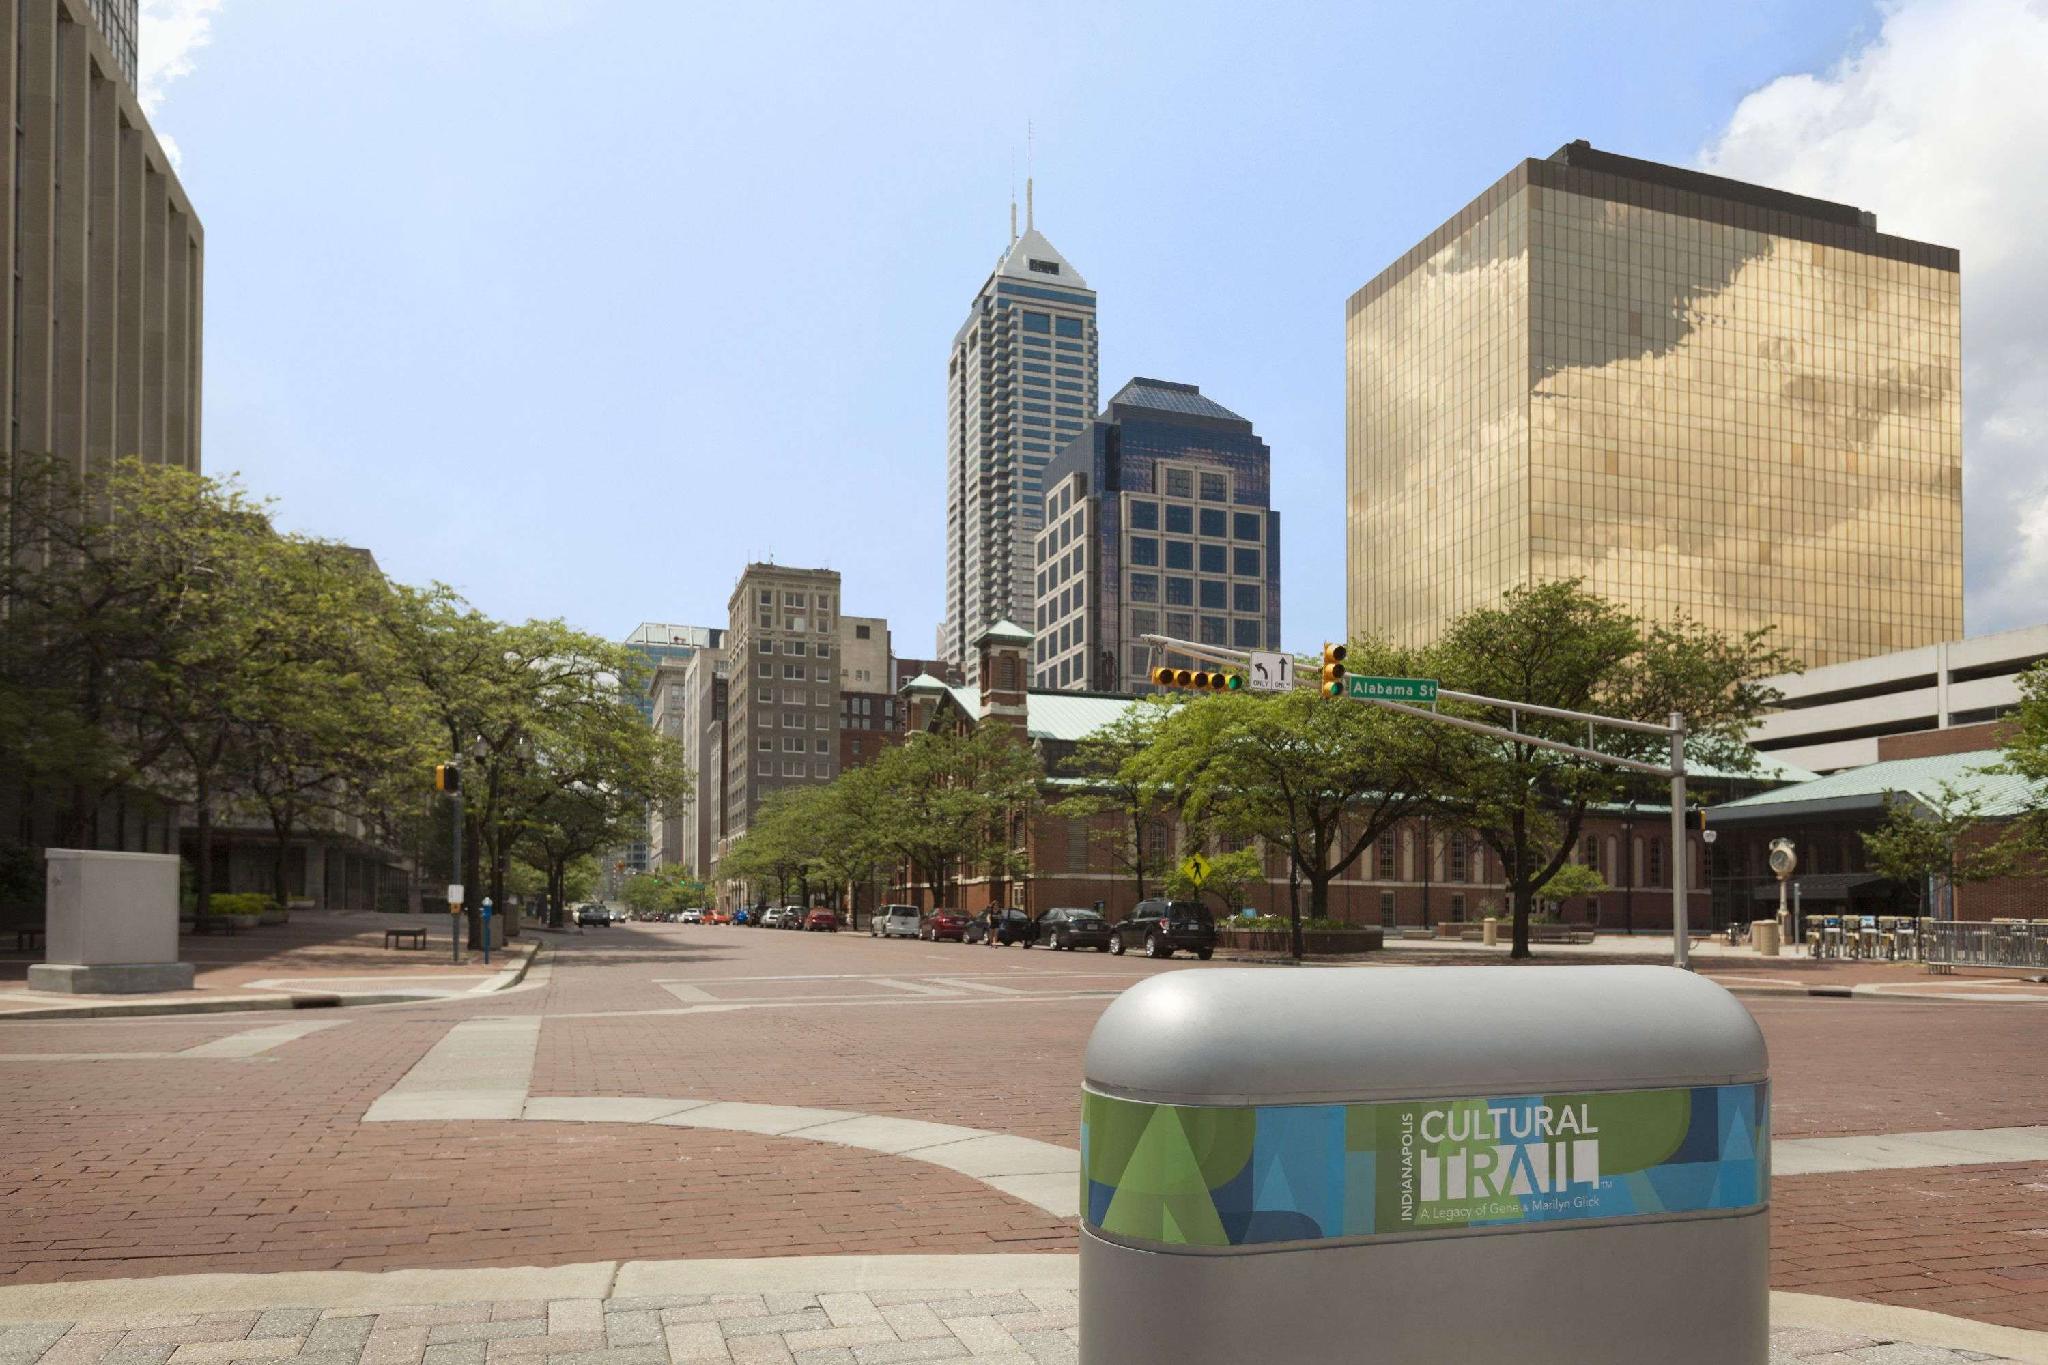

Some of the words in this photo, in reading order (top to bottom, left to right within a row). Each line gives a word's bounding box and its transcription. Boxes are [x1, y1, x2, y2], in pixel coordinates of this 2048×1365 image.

[1353, 681, 1413, 696] Alabama
[1419, 684, 1435, 697] St
[1420, 1104, 1599, 1143] CULTURAL
[1401, 1112, 1413, 1221] INDIANAPOLIS
[1420, 1139, 1600, 1202] TRAIL
[1420, 1209, 1431, 1220] A
[1433, 1206, 1471, 1221] Legacy
[1475, 1204, 1488, 1217] of
[1489, 1203, 1520, 1214] Gene
[1532, 1199, 1570, 1214] Marilyn
[1573, 1196, 1600, 1207] Glick
